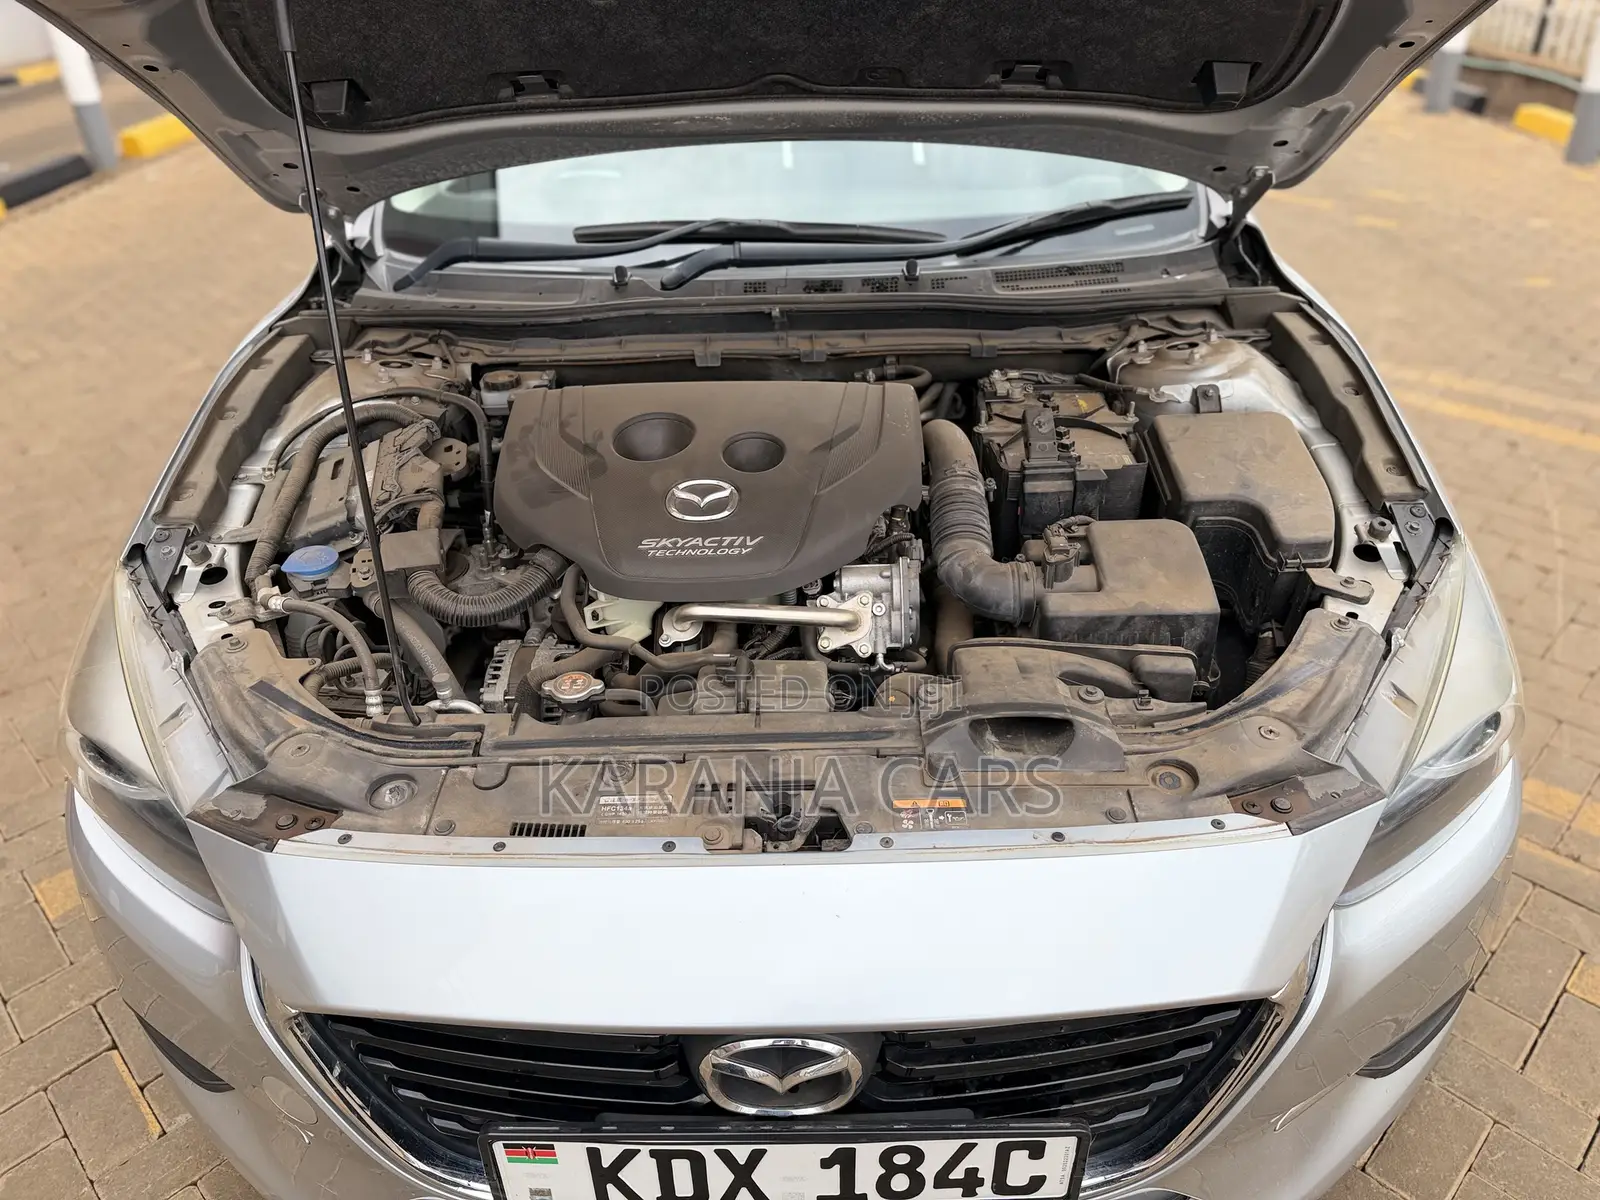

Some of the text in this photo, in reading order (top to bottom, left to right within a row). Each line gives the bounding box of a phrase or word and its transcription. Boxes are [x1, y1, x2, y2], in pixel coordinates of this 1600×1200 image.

[637, 536, 764, 549] SKYACTIV
[647, 547, 753, 557] TECHNOLOGY
[585, 1146, 772, 1200] KDX
[816, 1139, 1048, 1200] 184C
